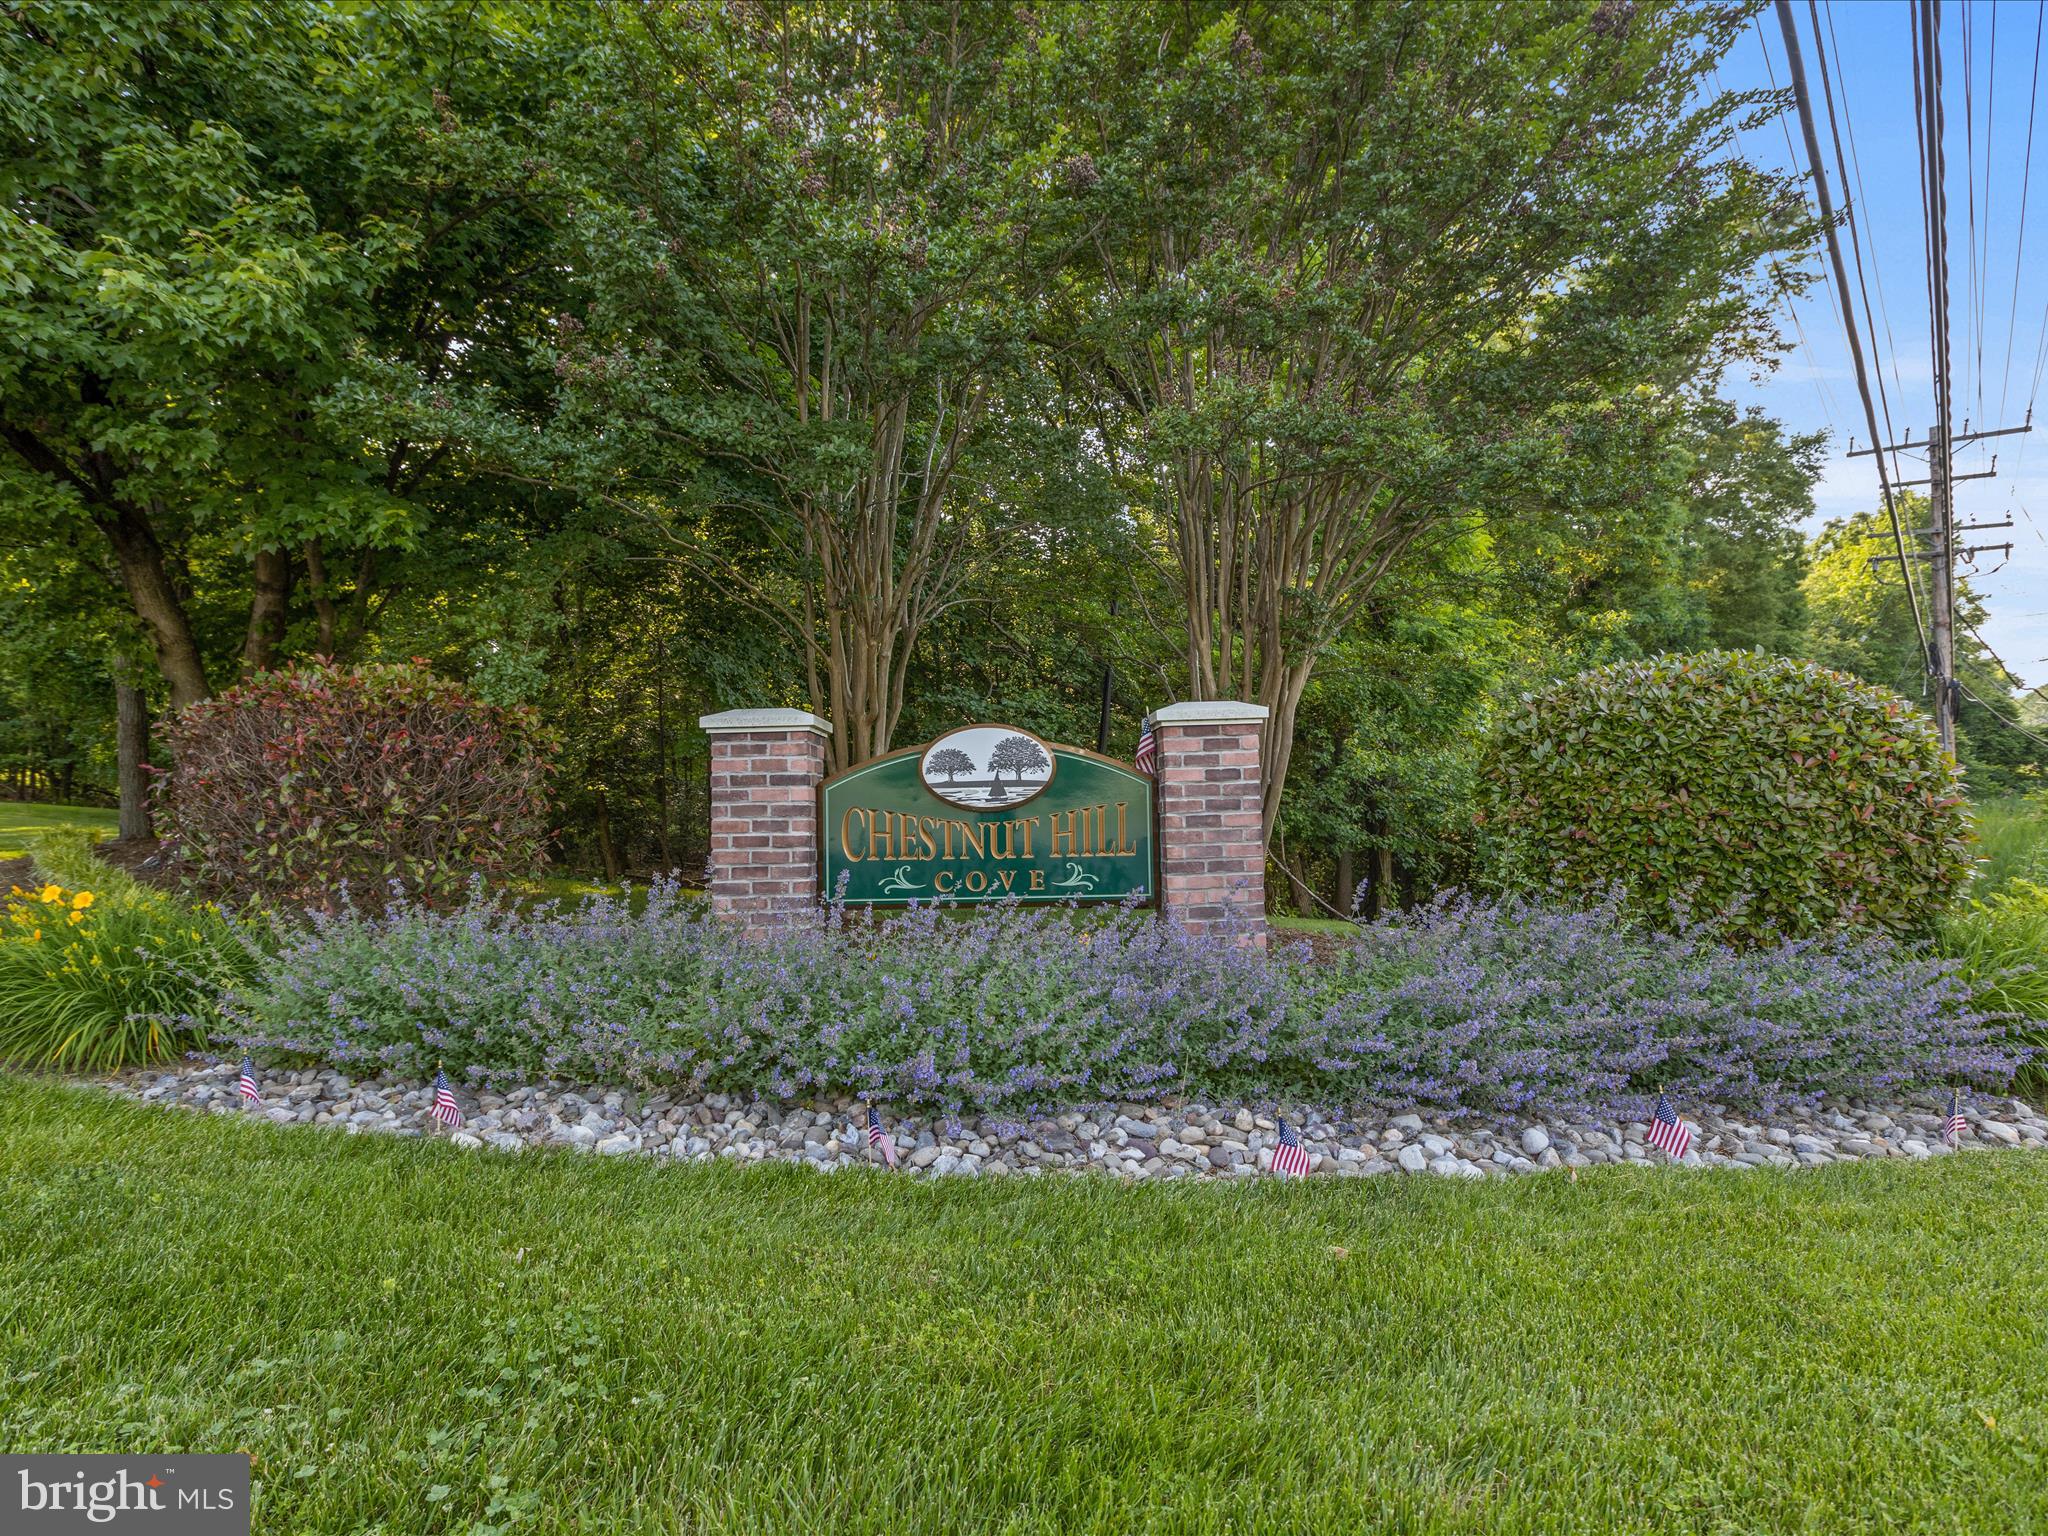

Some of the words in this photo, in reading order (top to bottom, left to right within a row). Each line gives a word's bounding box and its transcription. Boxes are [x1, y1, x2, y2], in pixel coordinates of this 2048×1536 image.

[841, 806, 1039, 862] CHESTNUT
[1049, 802, 1137, 858] HILL
[934, 869, 1046, 893] COVE
